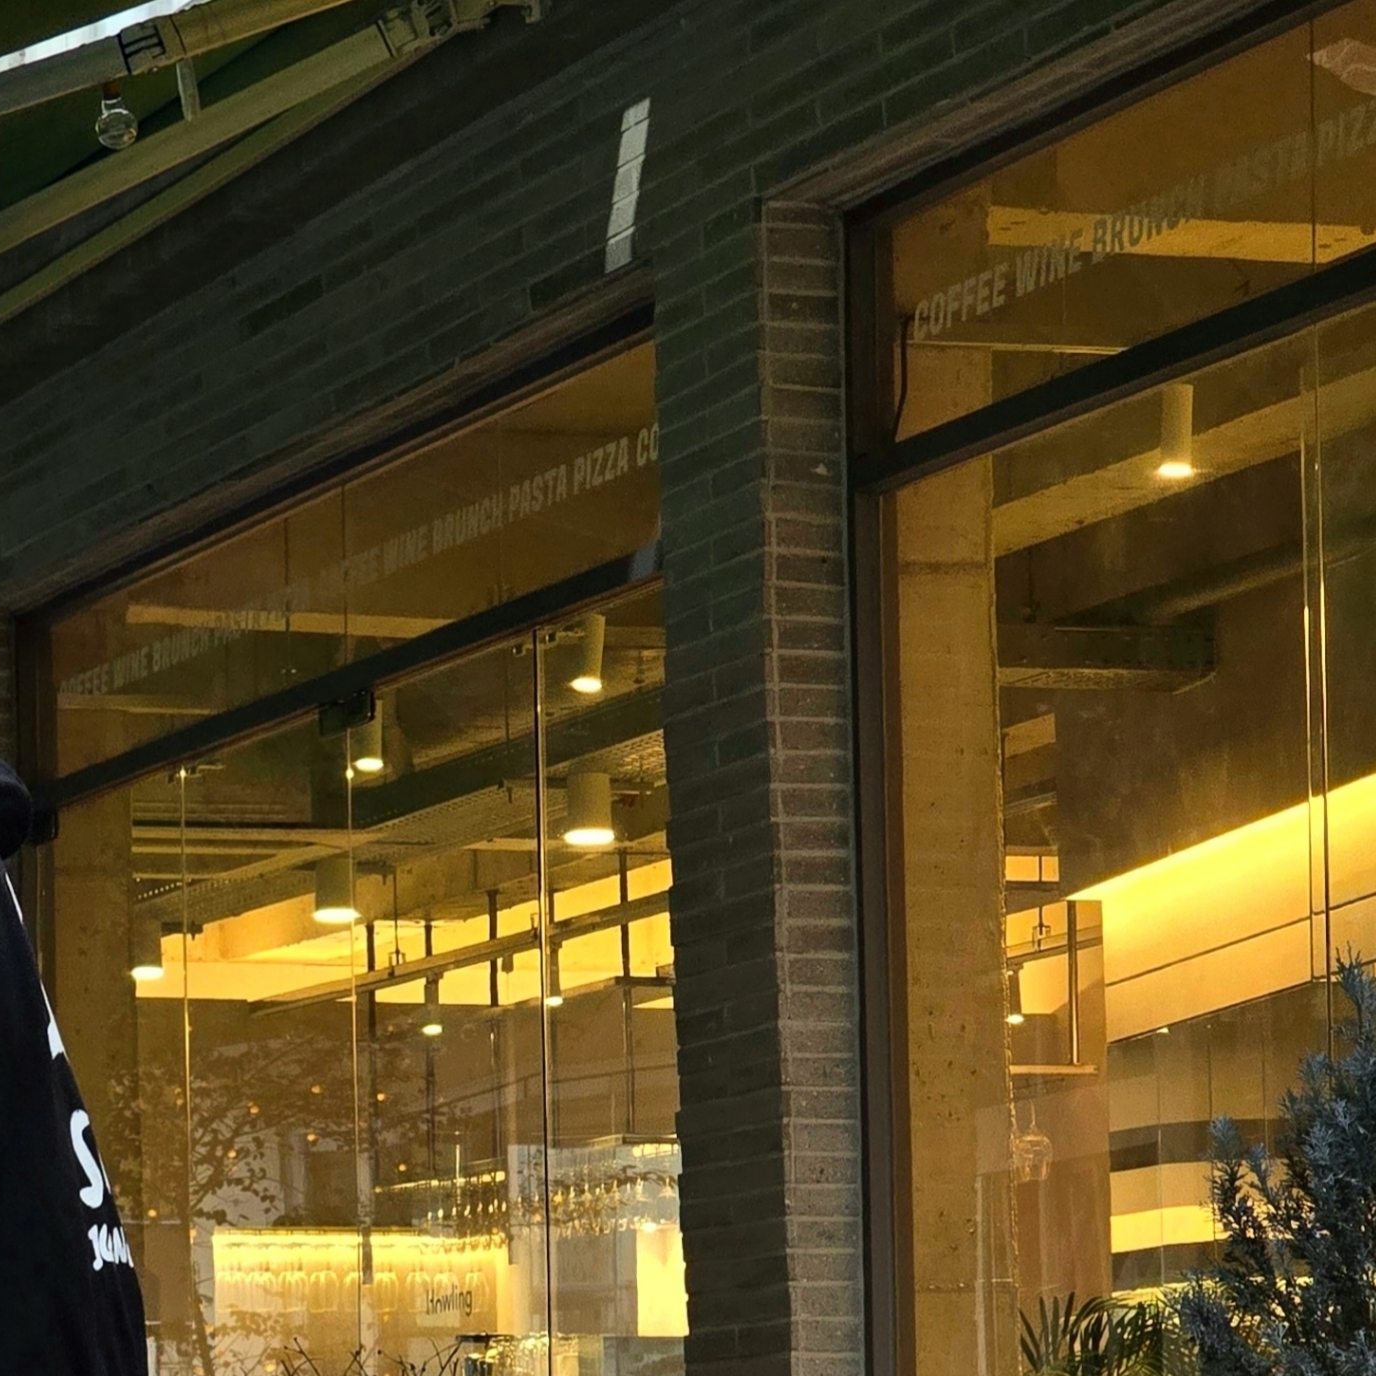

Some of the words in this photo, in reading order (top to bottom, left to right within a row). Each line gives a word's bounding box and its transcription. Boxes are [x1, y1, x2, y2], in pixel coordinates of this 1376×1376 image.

[913, 261, 1008, 342] COFFEE
[1014, 226, 1083, 300] WINE
[113, 644, 149, 690] WINE
[383, 523, 428, 580] WINE
[430, 488, 505, 557] BRUNCH
[508, 462, 567, 524] PASTA
[572, 435, 630, 497] PIZZA
[425, 1283, 473, 1317] Howling
